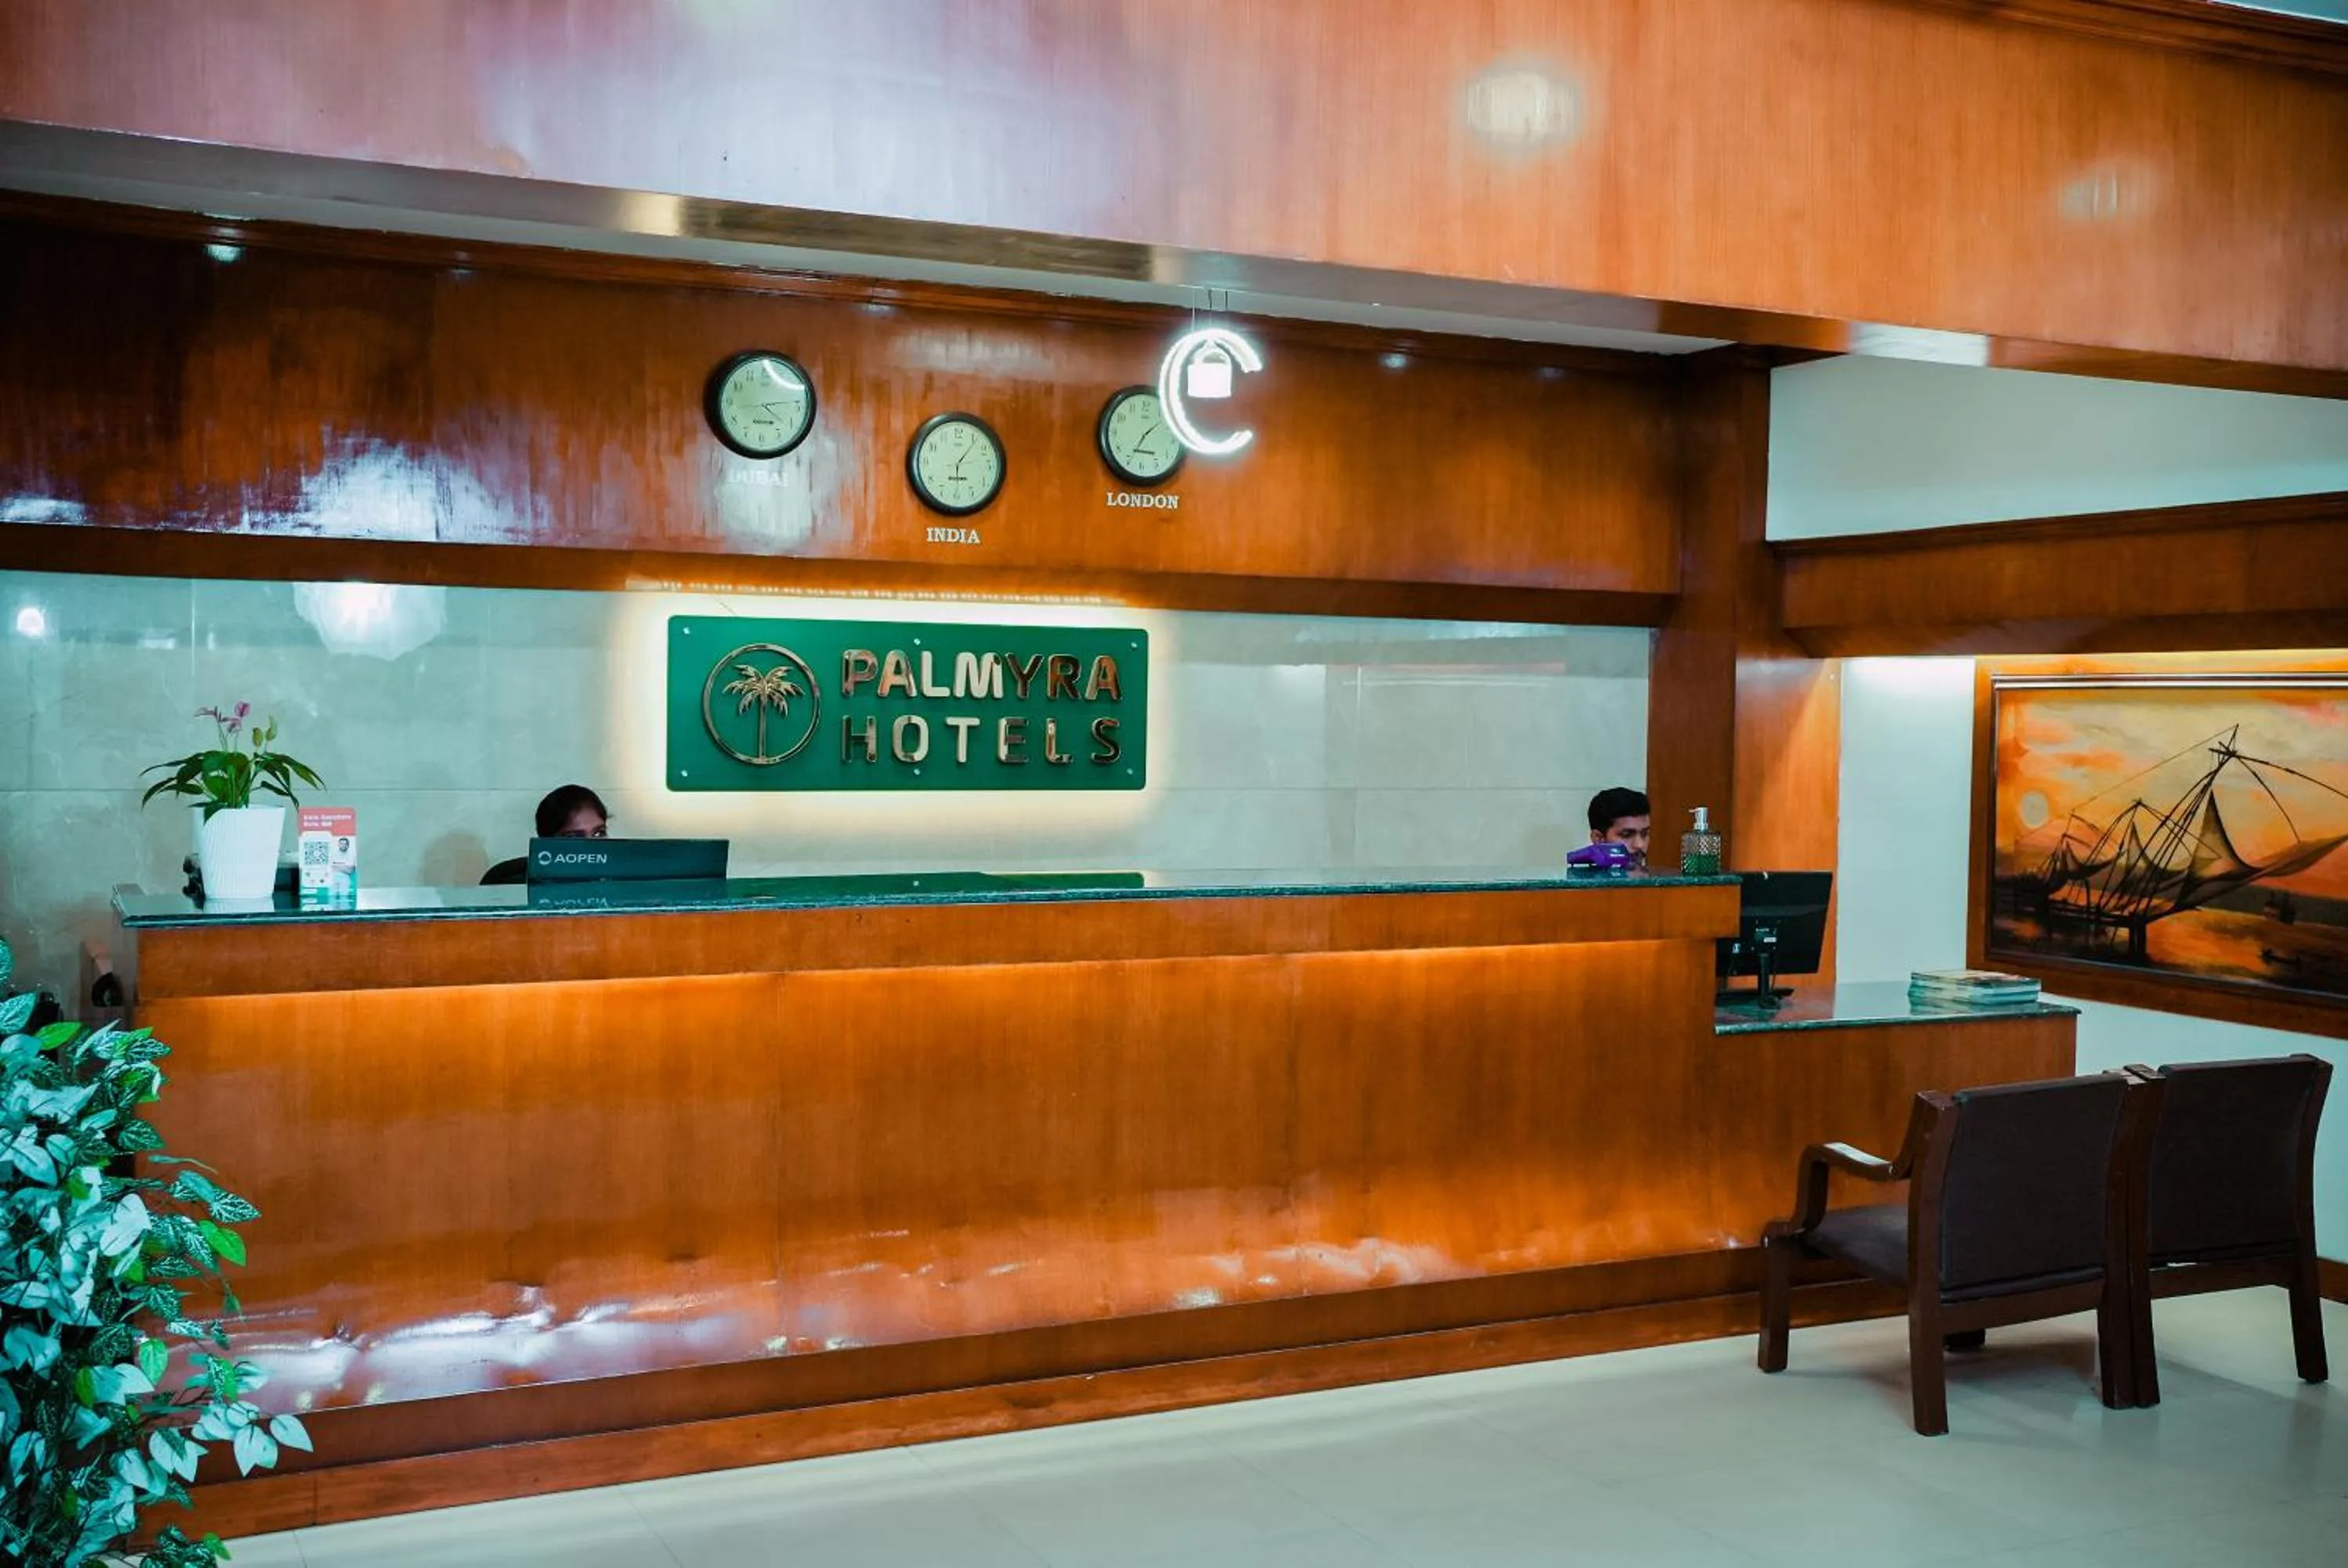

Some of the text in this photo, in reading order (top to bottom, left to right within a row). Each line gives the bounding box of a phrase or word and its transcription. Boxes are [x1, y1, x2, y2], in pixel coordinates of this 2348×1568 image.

[726, 469, 789, 487] DUBAI
[1106, 492, 1179, 509] LONDON
[926, 527, 981, 545] INDIA
[841, 649, 1123, 701] PALMYRA
[841, 714, 1122, 764] HOTELS
[553, 853, 608, 864] AOPEN
